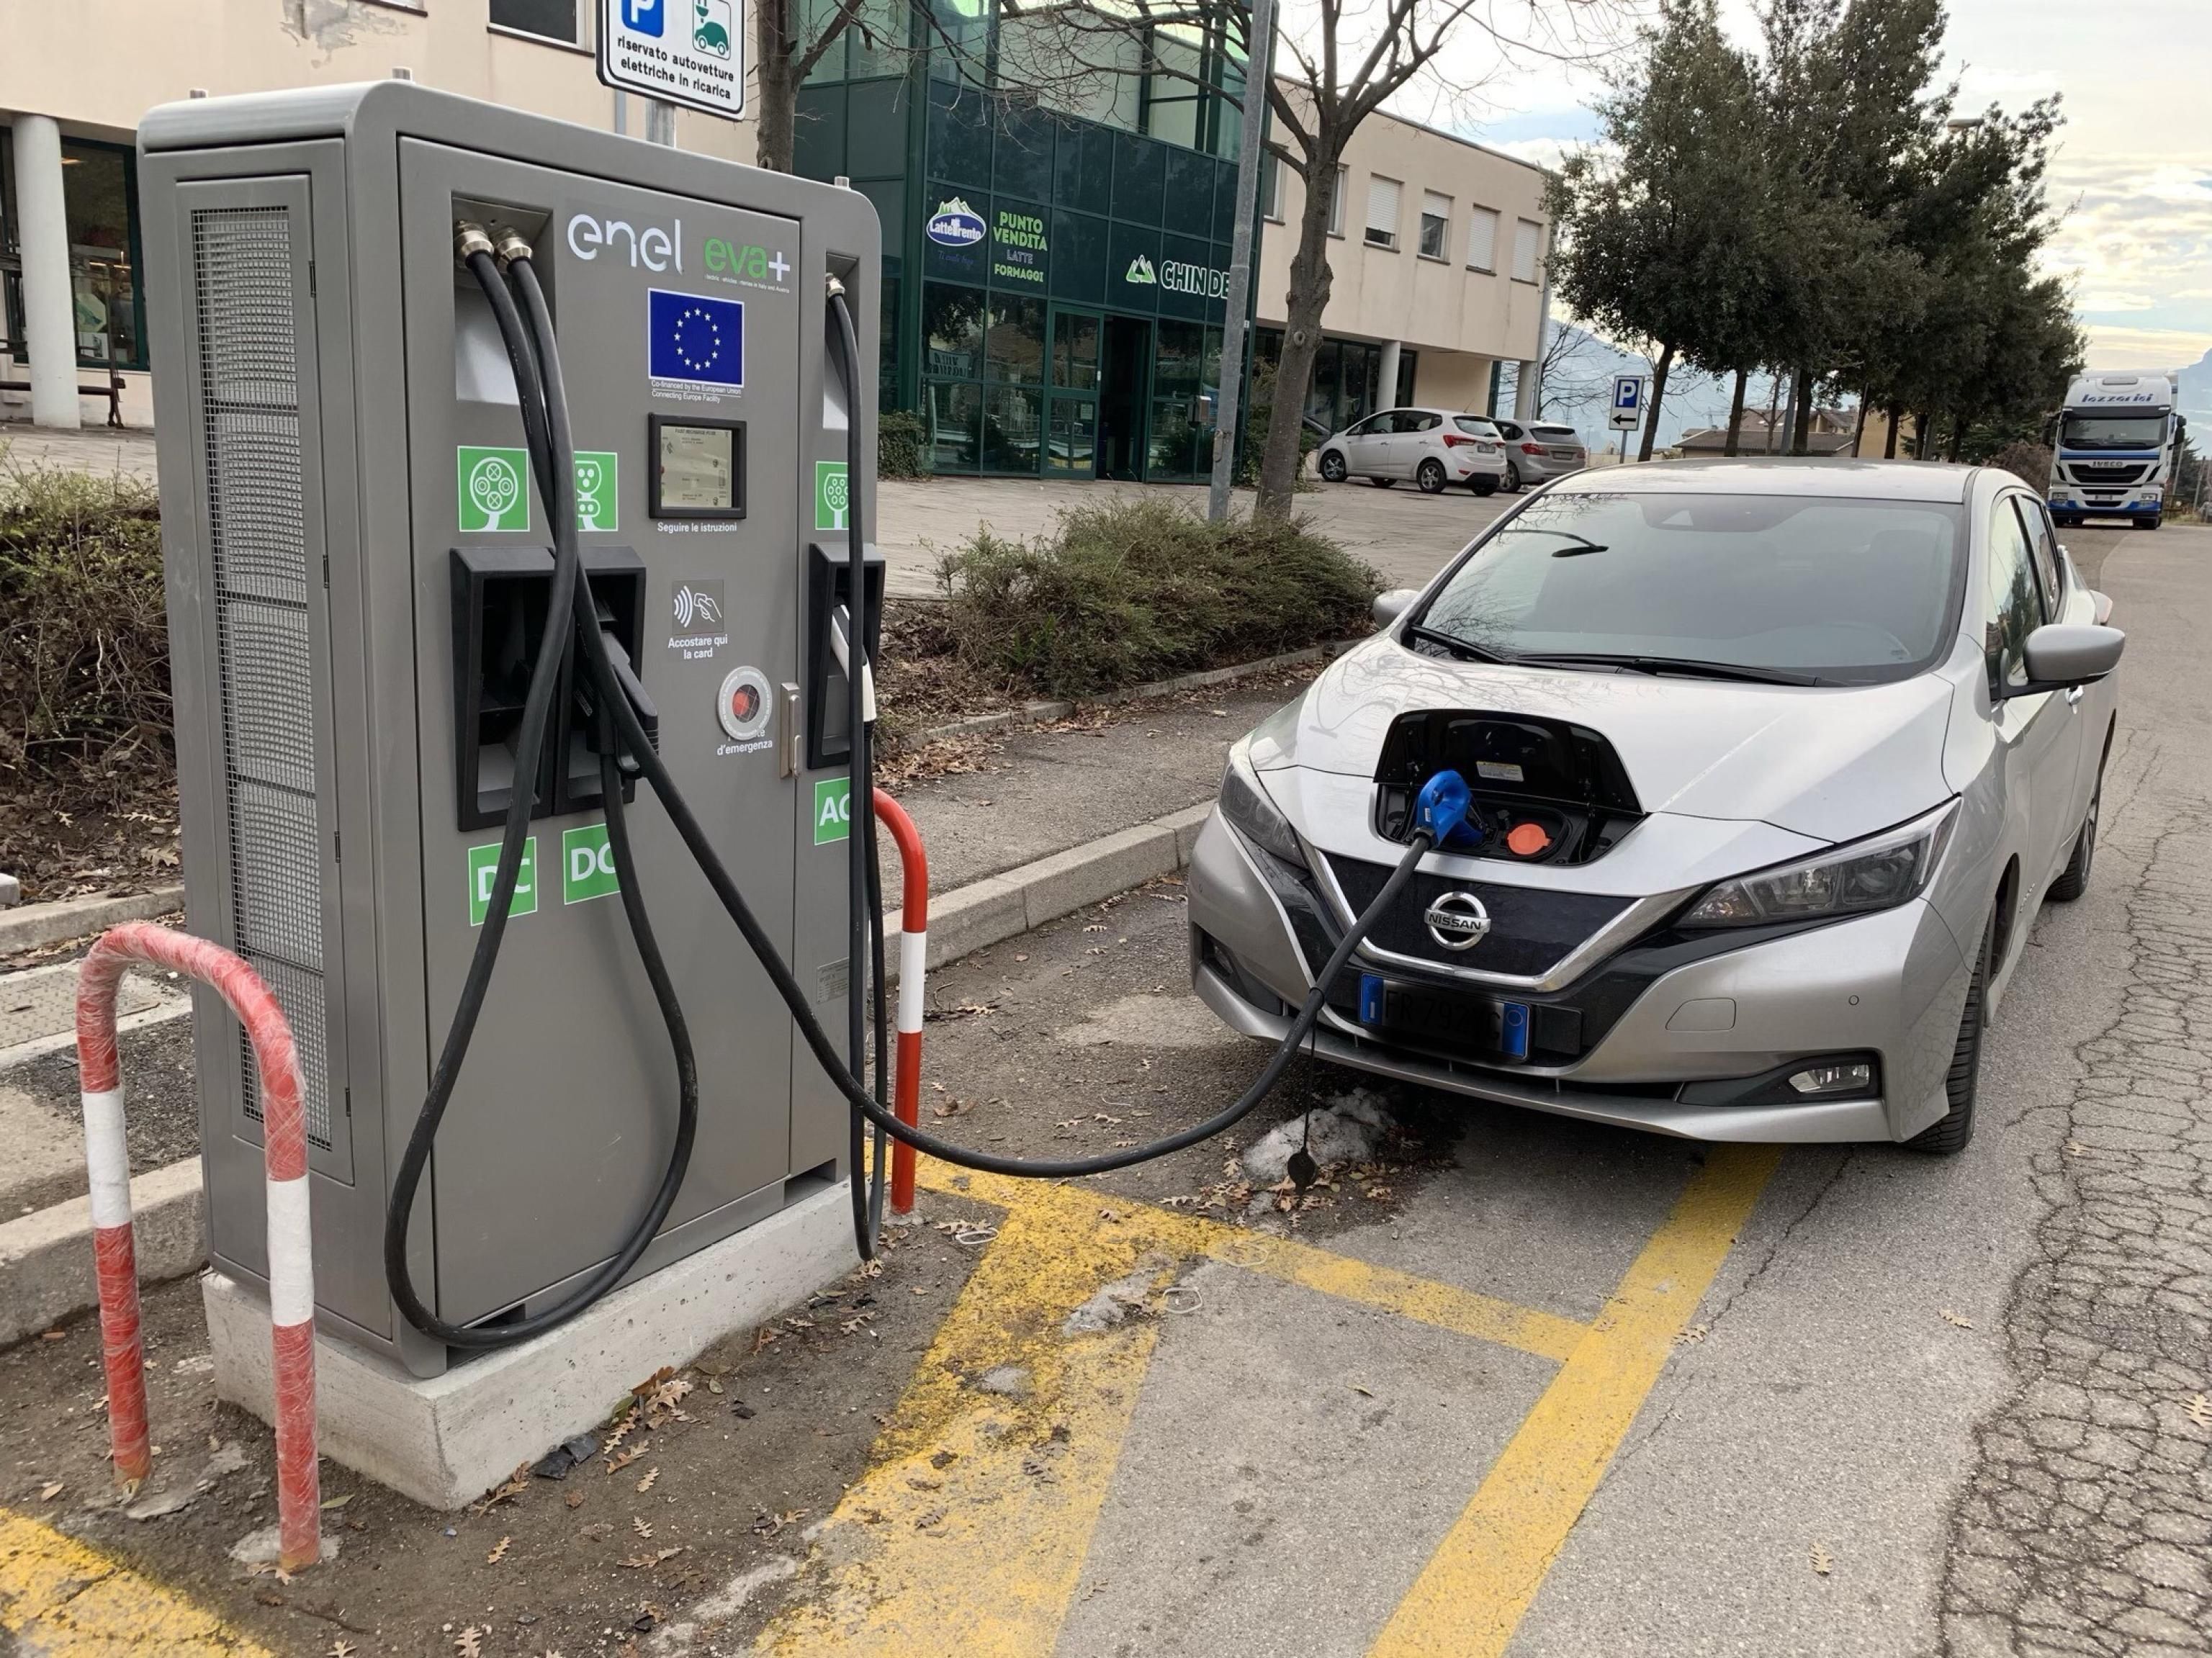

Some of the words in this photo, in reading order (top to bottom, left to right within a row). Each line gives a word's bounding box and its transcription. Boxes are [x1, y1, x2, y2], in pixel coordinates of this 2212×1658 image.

[617, 35, 667, 61] riservato
[673, 54, 734, 82] autovetture
[621, 57, 675, 83] elettriche
[679, 74, 688, 86] in
[693, 78, 731, 99] ricarica
[999, 211, 1043, 234] PUNTO
[567, 214, 683, 276] enel
[993, 226, 1048, 251] VENDITA
[1006, 249, 1034, 265] LATTE
[994, 263, 1044, 283] FORMAGGI
[1160, 259, 1208, 296] CHIN
[651, 379, 683, 389] Co-financed
[684, 383, 691, 392] by
[701, 384, 726, 393] European
[1618, 381, 1637, 405] P
[651, 389, 683, 400] Connecting
[683, 392, 702, 402] Europe
[657, 521, 690, 534] Seguire
[692, 523, 699, 532] le
[701, 522, 737, 532] istruzioni
[667, 637, 711, 649] Accostare
[714, 634, 728, 647] qui
[683, 649, 692, 659] la
[694, 648, 713, 659] card
[716, 739, 773, 756] d'emergenza
[1428, 913, 1482, 930] NISSAN
